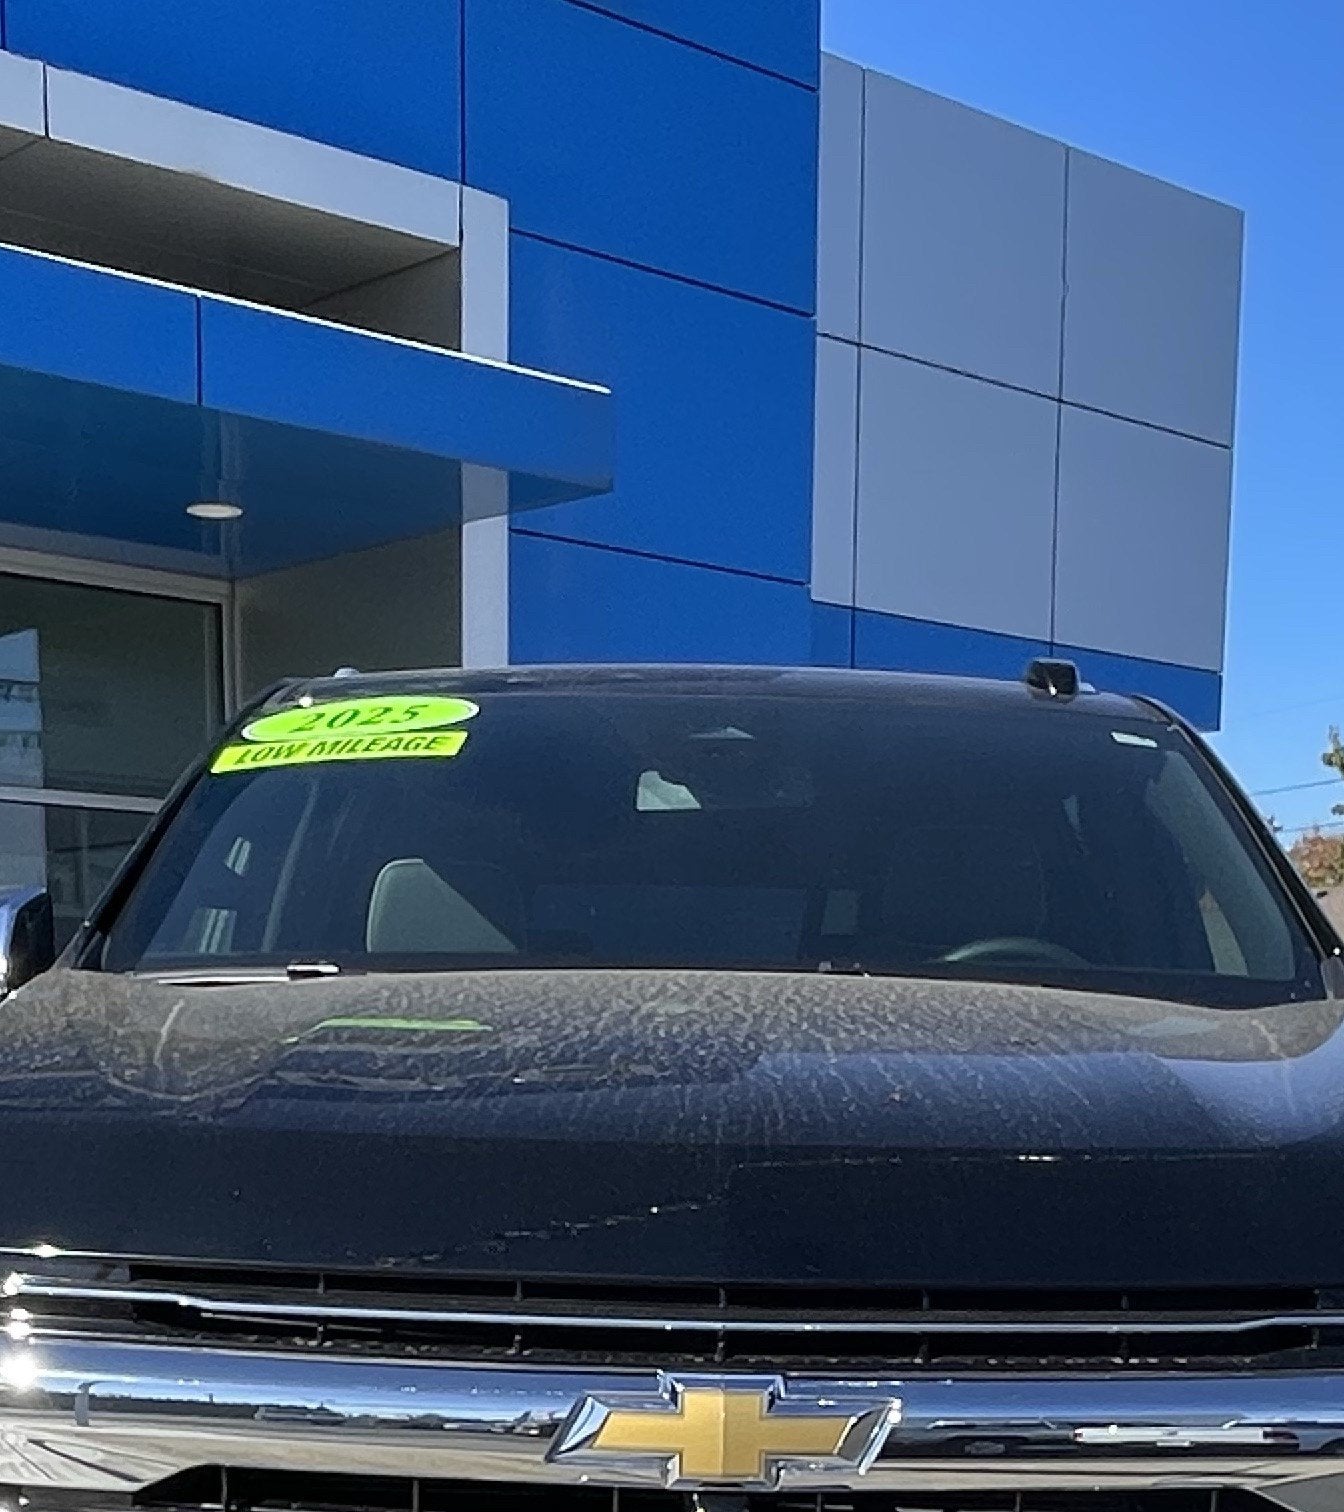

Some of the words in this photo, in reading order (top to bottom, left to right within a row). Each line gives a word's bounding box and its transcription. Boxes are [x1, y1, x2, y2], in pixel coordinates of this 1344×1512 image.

[288, 704, 429, 733] 2025
[233, 741, 302, 766] LOW
[306, 735, 453, 758] MILEAGE
